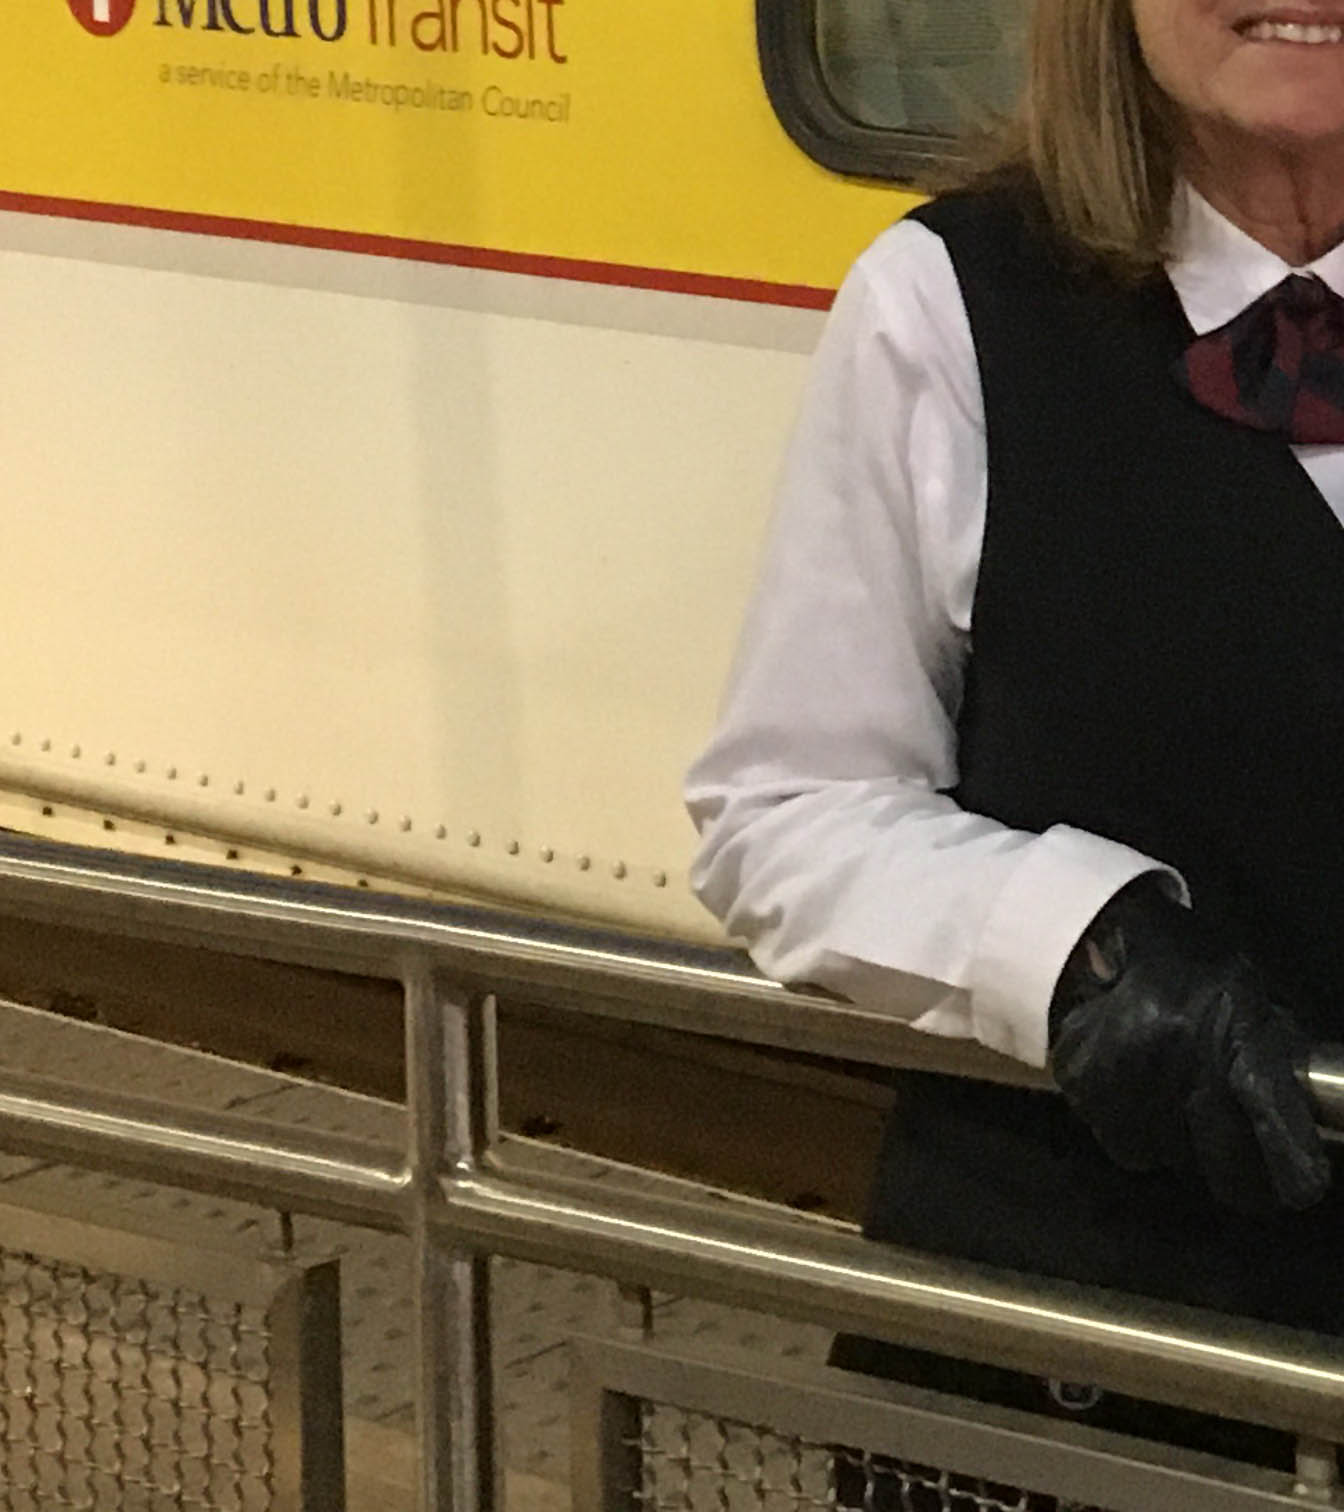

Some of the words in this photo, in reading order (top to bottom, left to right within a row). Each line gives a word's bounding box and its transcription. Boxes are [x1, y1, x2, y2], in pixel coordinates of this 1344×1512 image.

[158, 63, 172, 84] a
[175, 63, 251, 91] service
[257, 62, 282, 94] of
[285, 66, 321, 99] the
[327, 70, 473, 113] Metropolitan
[482, 84, 572, 123] Council
